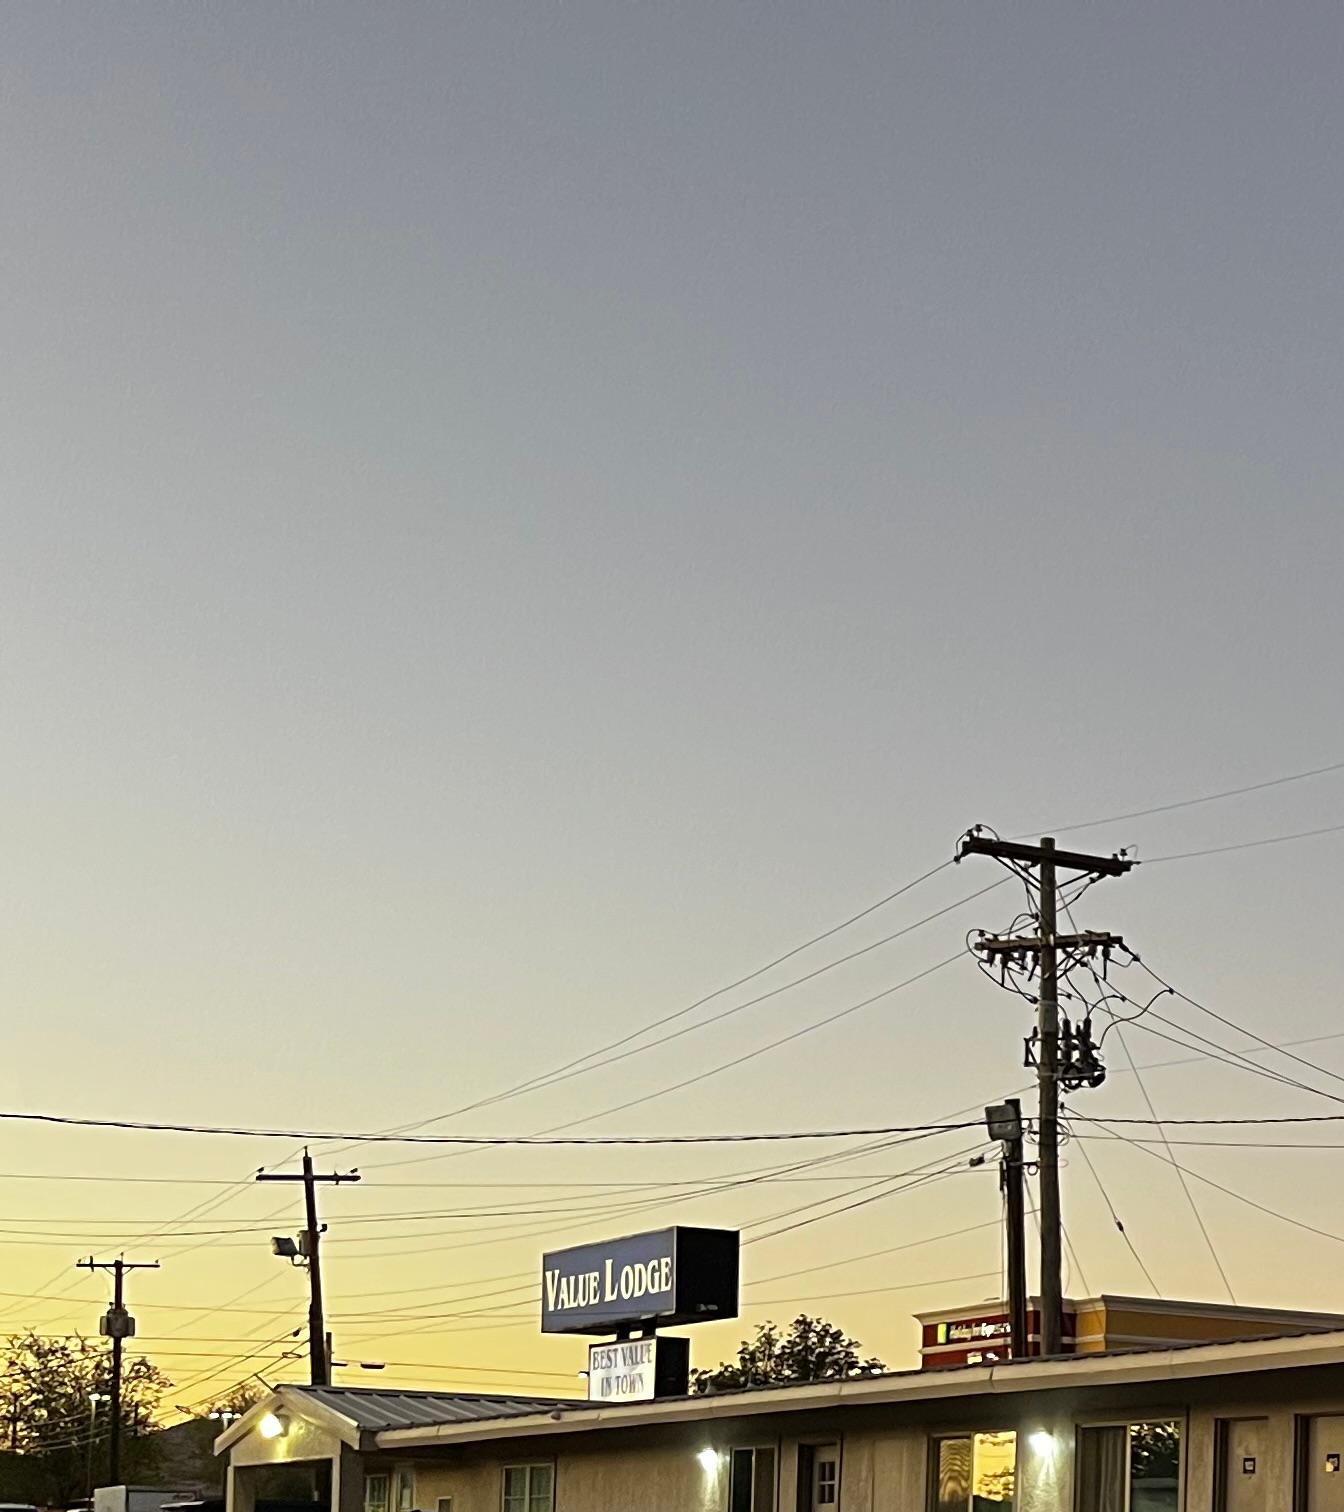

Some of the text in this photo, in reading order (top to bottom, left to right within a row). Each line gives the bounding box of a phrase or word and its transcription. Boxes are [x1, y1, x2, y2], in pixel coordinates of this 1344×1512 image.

[593, 1343, 652, 1371] BEST VALUE
[601, 1373, 644, 1397] IN TOWN
